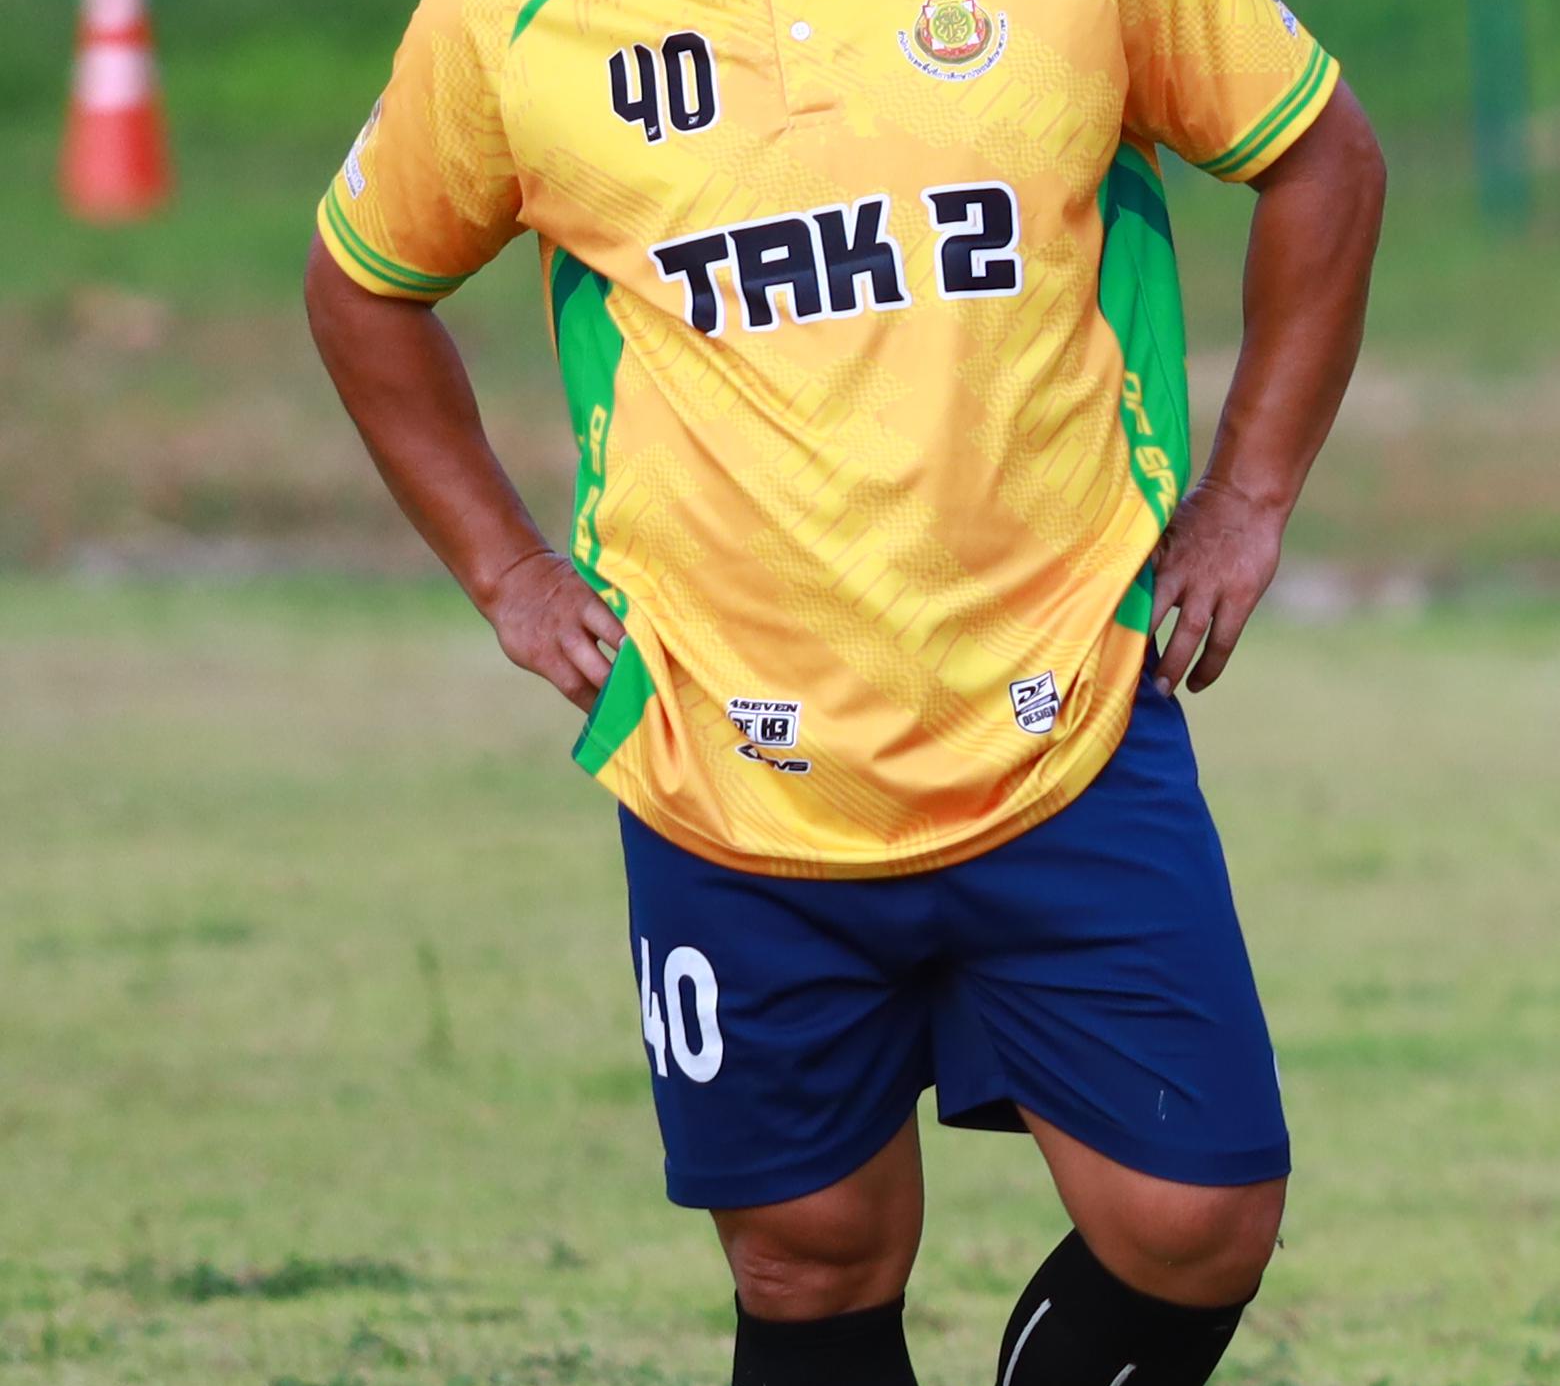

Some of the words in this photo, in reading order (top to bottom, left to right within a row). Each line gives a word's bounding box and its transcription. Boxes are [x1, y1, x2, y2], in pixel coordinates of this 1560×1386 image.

[608, 31, 716, 143] 40
[652, 200, 905, 334] TAK
[926, 187, 1016, 293] 2
[640, 936, 724, 1083] 40
